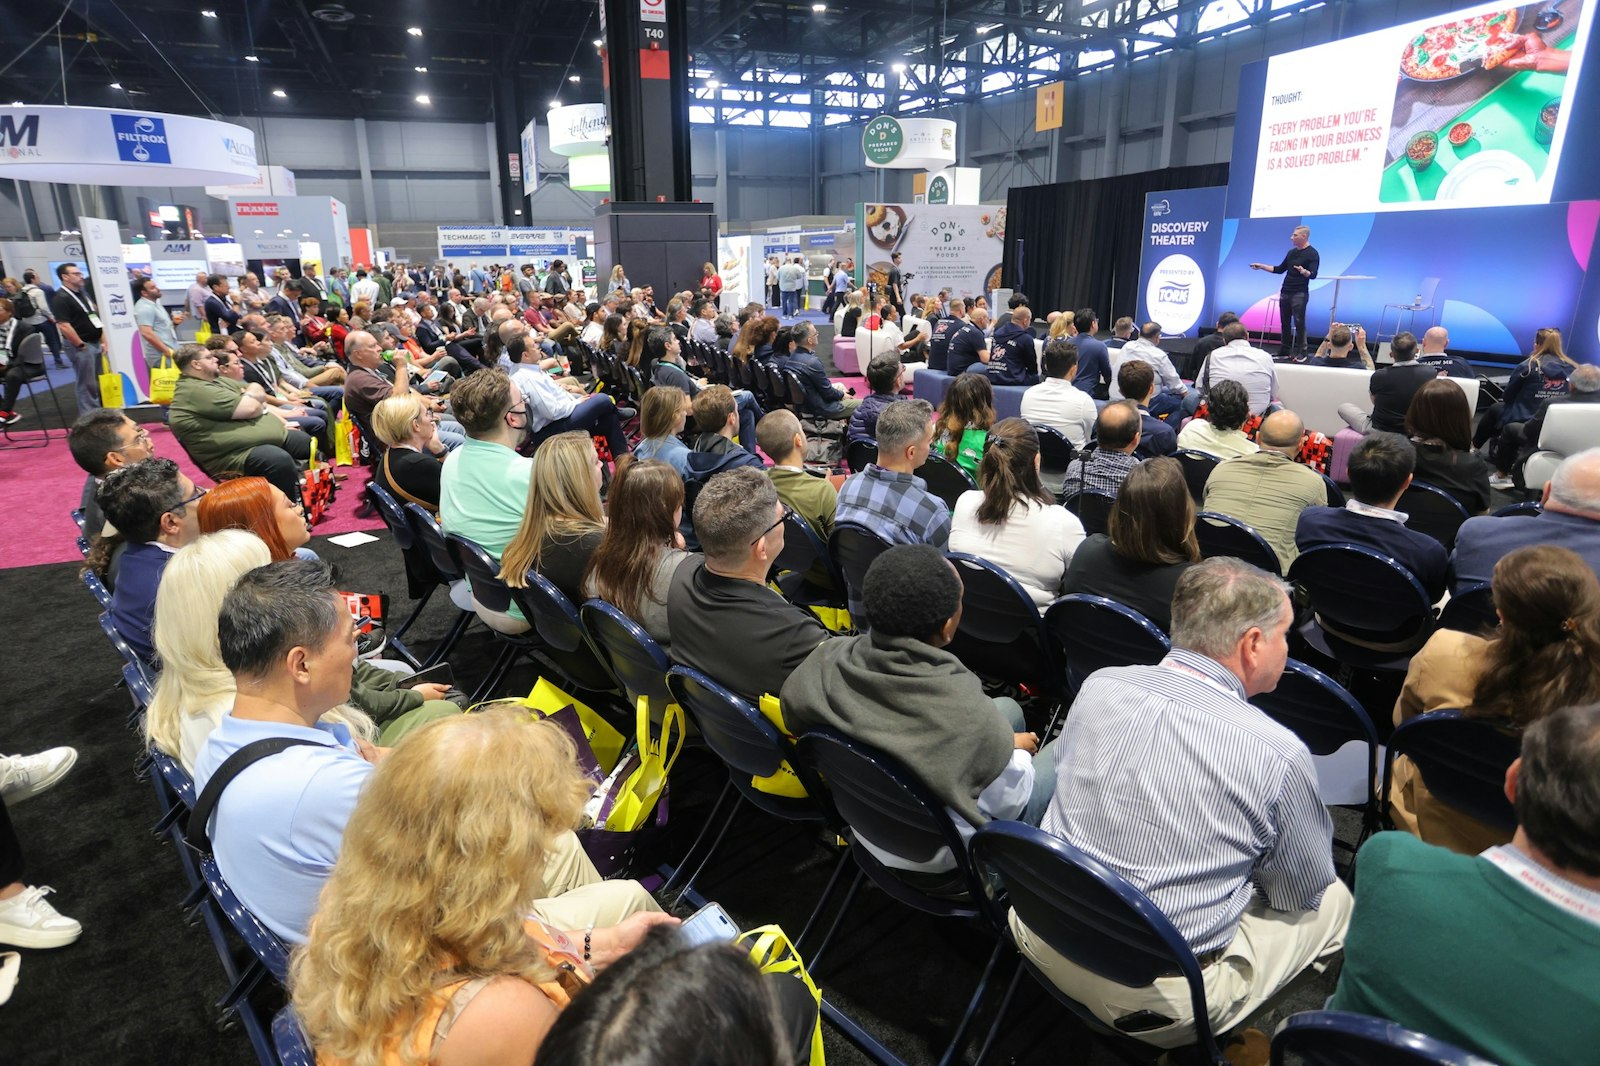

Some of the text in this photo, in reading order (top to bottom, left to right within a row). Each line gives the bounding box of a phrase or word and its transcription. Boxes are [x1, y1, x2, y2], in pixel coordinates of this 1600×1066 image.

[645, 28, 664, 38] T40
[1272, 91, 1303, 106] THOUGHT:
[1300, 114, 1340, 132] PROBLEM
[1344, 108, 1378, 126] YOU'RE
[870, 122, 897, 136] DON'S
[880, 132, 886, 140] D
[118, 132, 166, 144] FILTROX
[1270, 126, 1382, 153] FACING IN YOUR BUSINESS
[1267, 158, 1276, 170] IS
[1276, 157, 1282, 169] A
[1284, 154, 1315, 168] SOLVED
[931, 221, 966, 236] DON'S
[1152, 222, 1209, 233] DISCOVERY
[944, 233, 952, 242] D
[1150, 235, 1194, 245] THEATER
[164, 244, 191, 252] AIM
[1160, 288, 1189, 304] TORK
[1520, 869, 1585, 912] Restaurant
